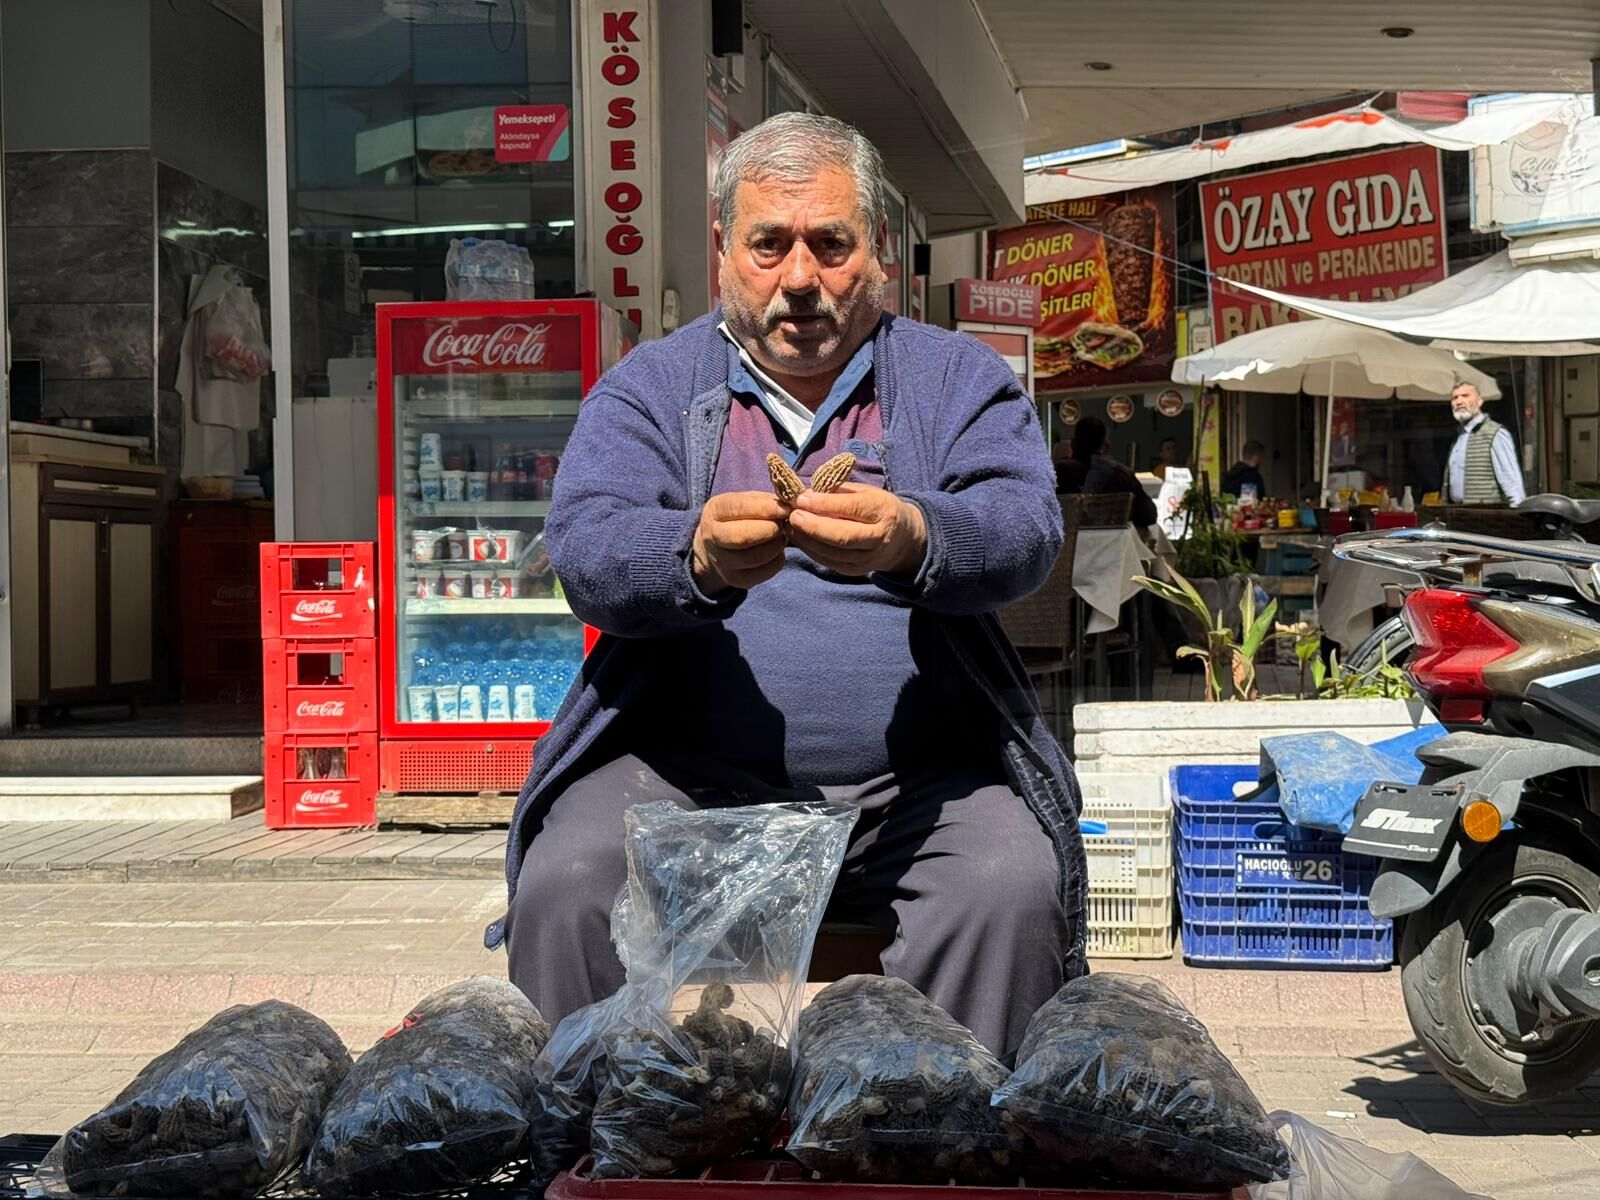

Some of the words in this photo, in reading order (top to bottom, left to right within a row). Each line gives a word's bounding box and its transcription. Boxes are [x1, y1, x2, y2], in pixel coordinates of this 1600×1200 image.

[499, 114, 556, 126] Yemeksepeti
[602, 11, 643, 333] KÖSEOĞL
[1213, 186, 1315, 255] ÖZAY
[1326, 168, 1435, 238] GIDA
[1006, 232, 1074, 266] DÖNER
[1216, 257, 1288, 294] TOPTAN
[1291, 261, 1313, 285] ve
[1317, 236, 1436, 282] PERAKENDE
[1030, 259, 1097, 288] DÖNER
[422, 322, 552, 367] Coca-Cola
[1302, 859, 1333, 881] 26
